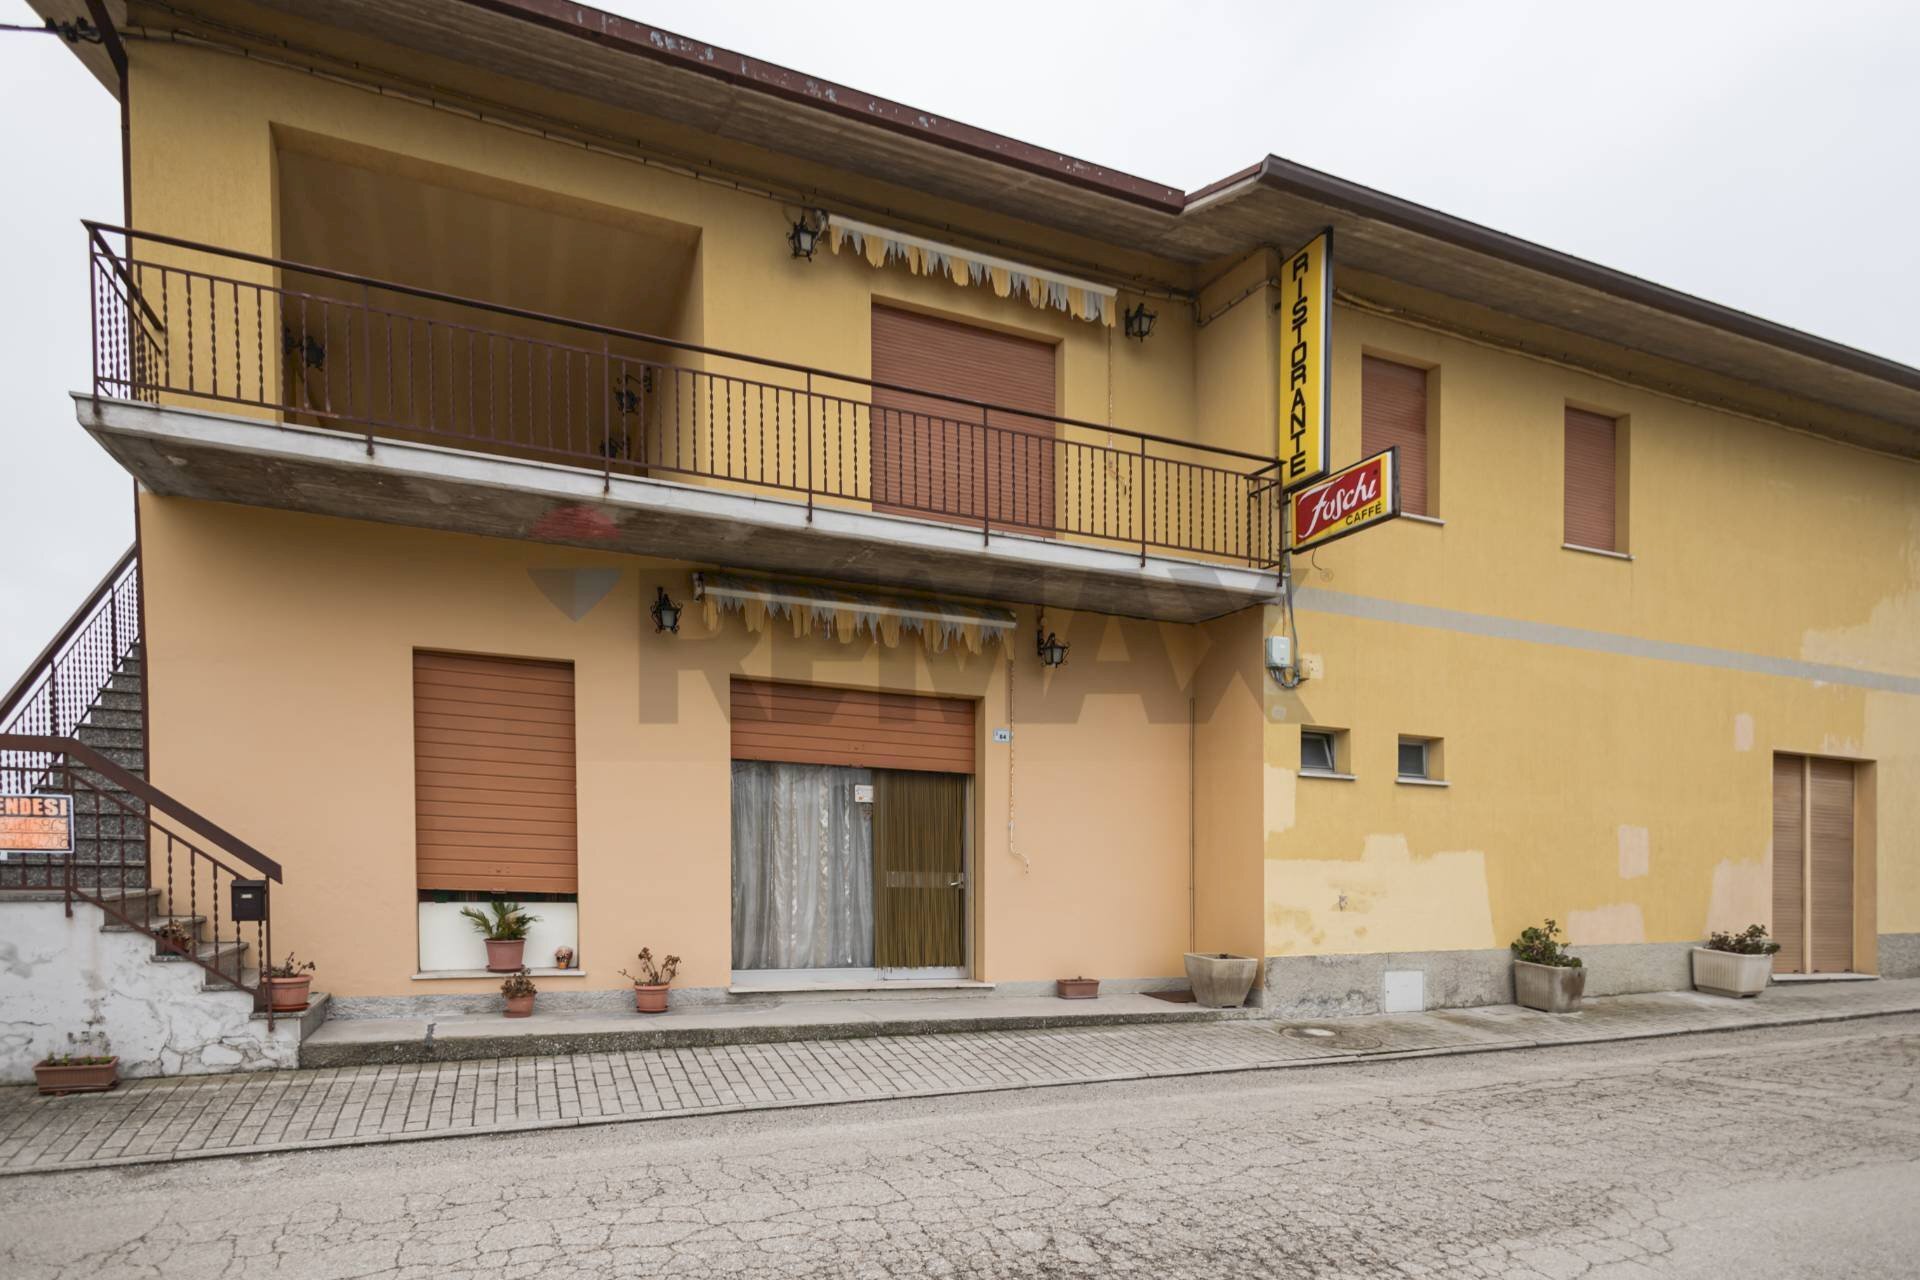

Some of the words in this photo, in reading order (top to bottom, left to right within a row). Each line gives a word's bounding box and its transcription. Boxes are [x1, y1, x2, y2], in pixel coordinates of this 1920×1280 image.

[1290, 252, 1309, 478] RISTORANTE
[1297, 471, 1378, 538] Foschi
[1345, 501, 1382, 526] CAFFÈ
